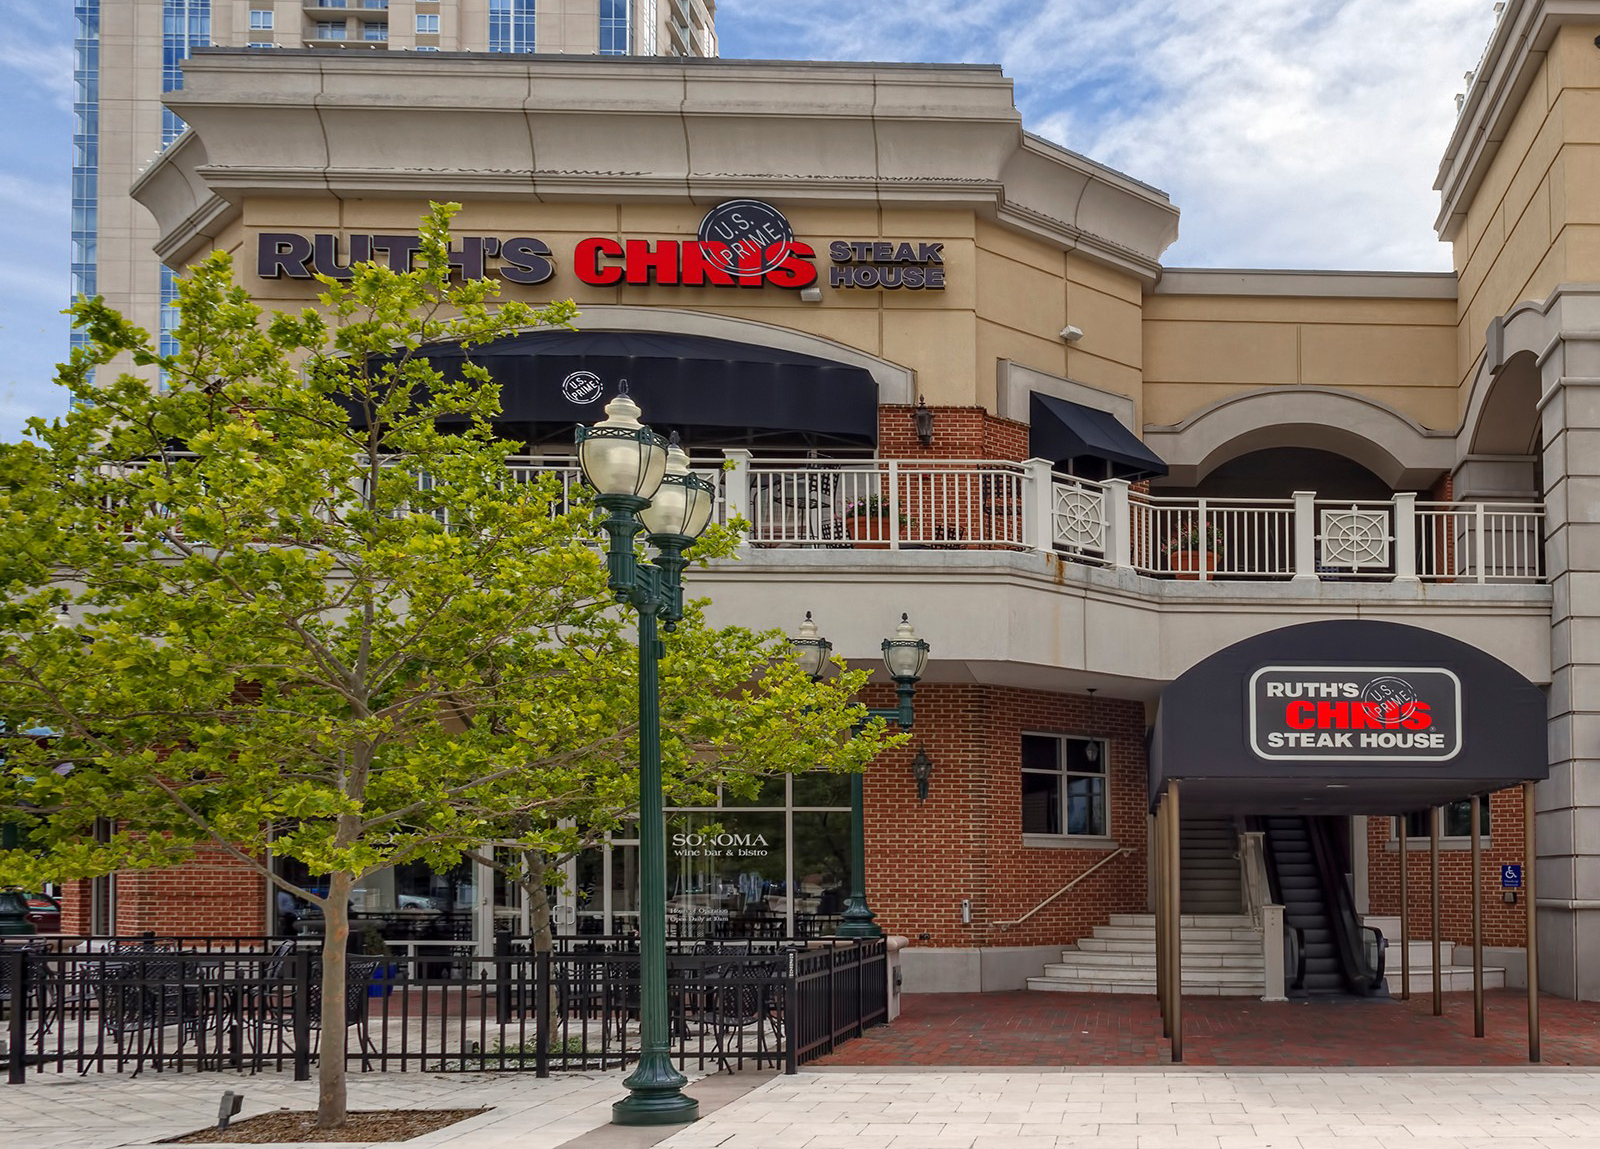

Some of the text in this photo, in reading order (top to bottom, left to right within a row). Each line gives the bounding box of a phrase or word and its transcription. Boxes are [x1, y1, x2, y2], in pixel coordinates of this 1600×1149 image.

[714, 213, 754, 241] U.S.
[719, 221, 782, 267] PRIME
[828, 241, 945, 264] STEAK
[574, 237, 818, 289] CHRIS
[829, 266, 945, 290] HOUSE
[569, 377, 587, 389] U.S.
[571, 380, 598, 401] PRIME
[1266, 681, 1395, 702] RUTH'S U.S.
[1285, 700, 1433, 730] CHRIS
[1373, 690, 1411, 718] PRIME
[1267, 732, 1446, 749] STEAK HOUSE
[672, 833, 769, 847] SONOMA
[674, 848, 768, 857] wine bar & bistro
